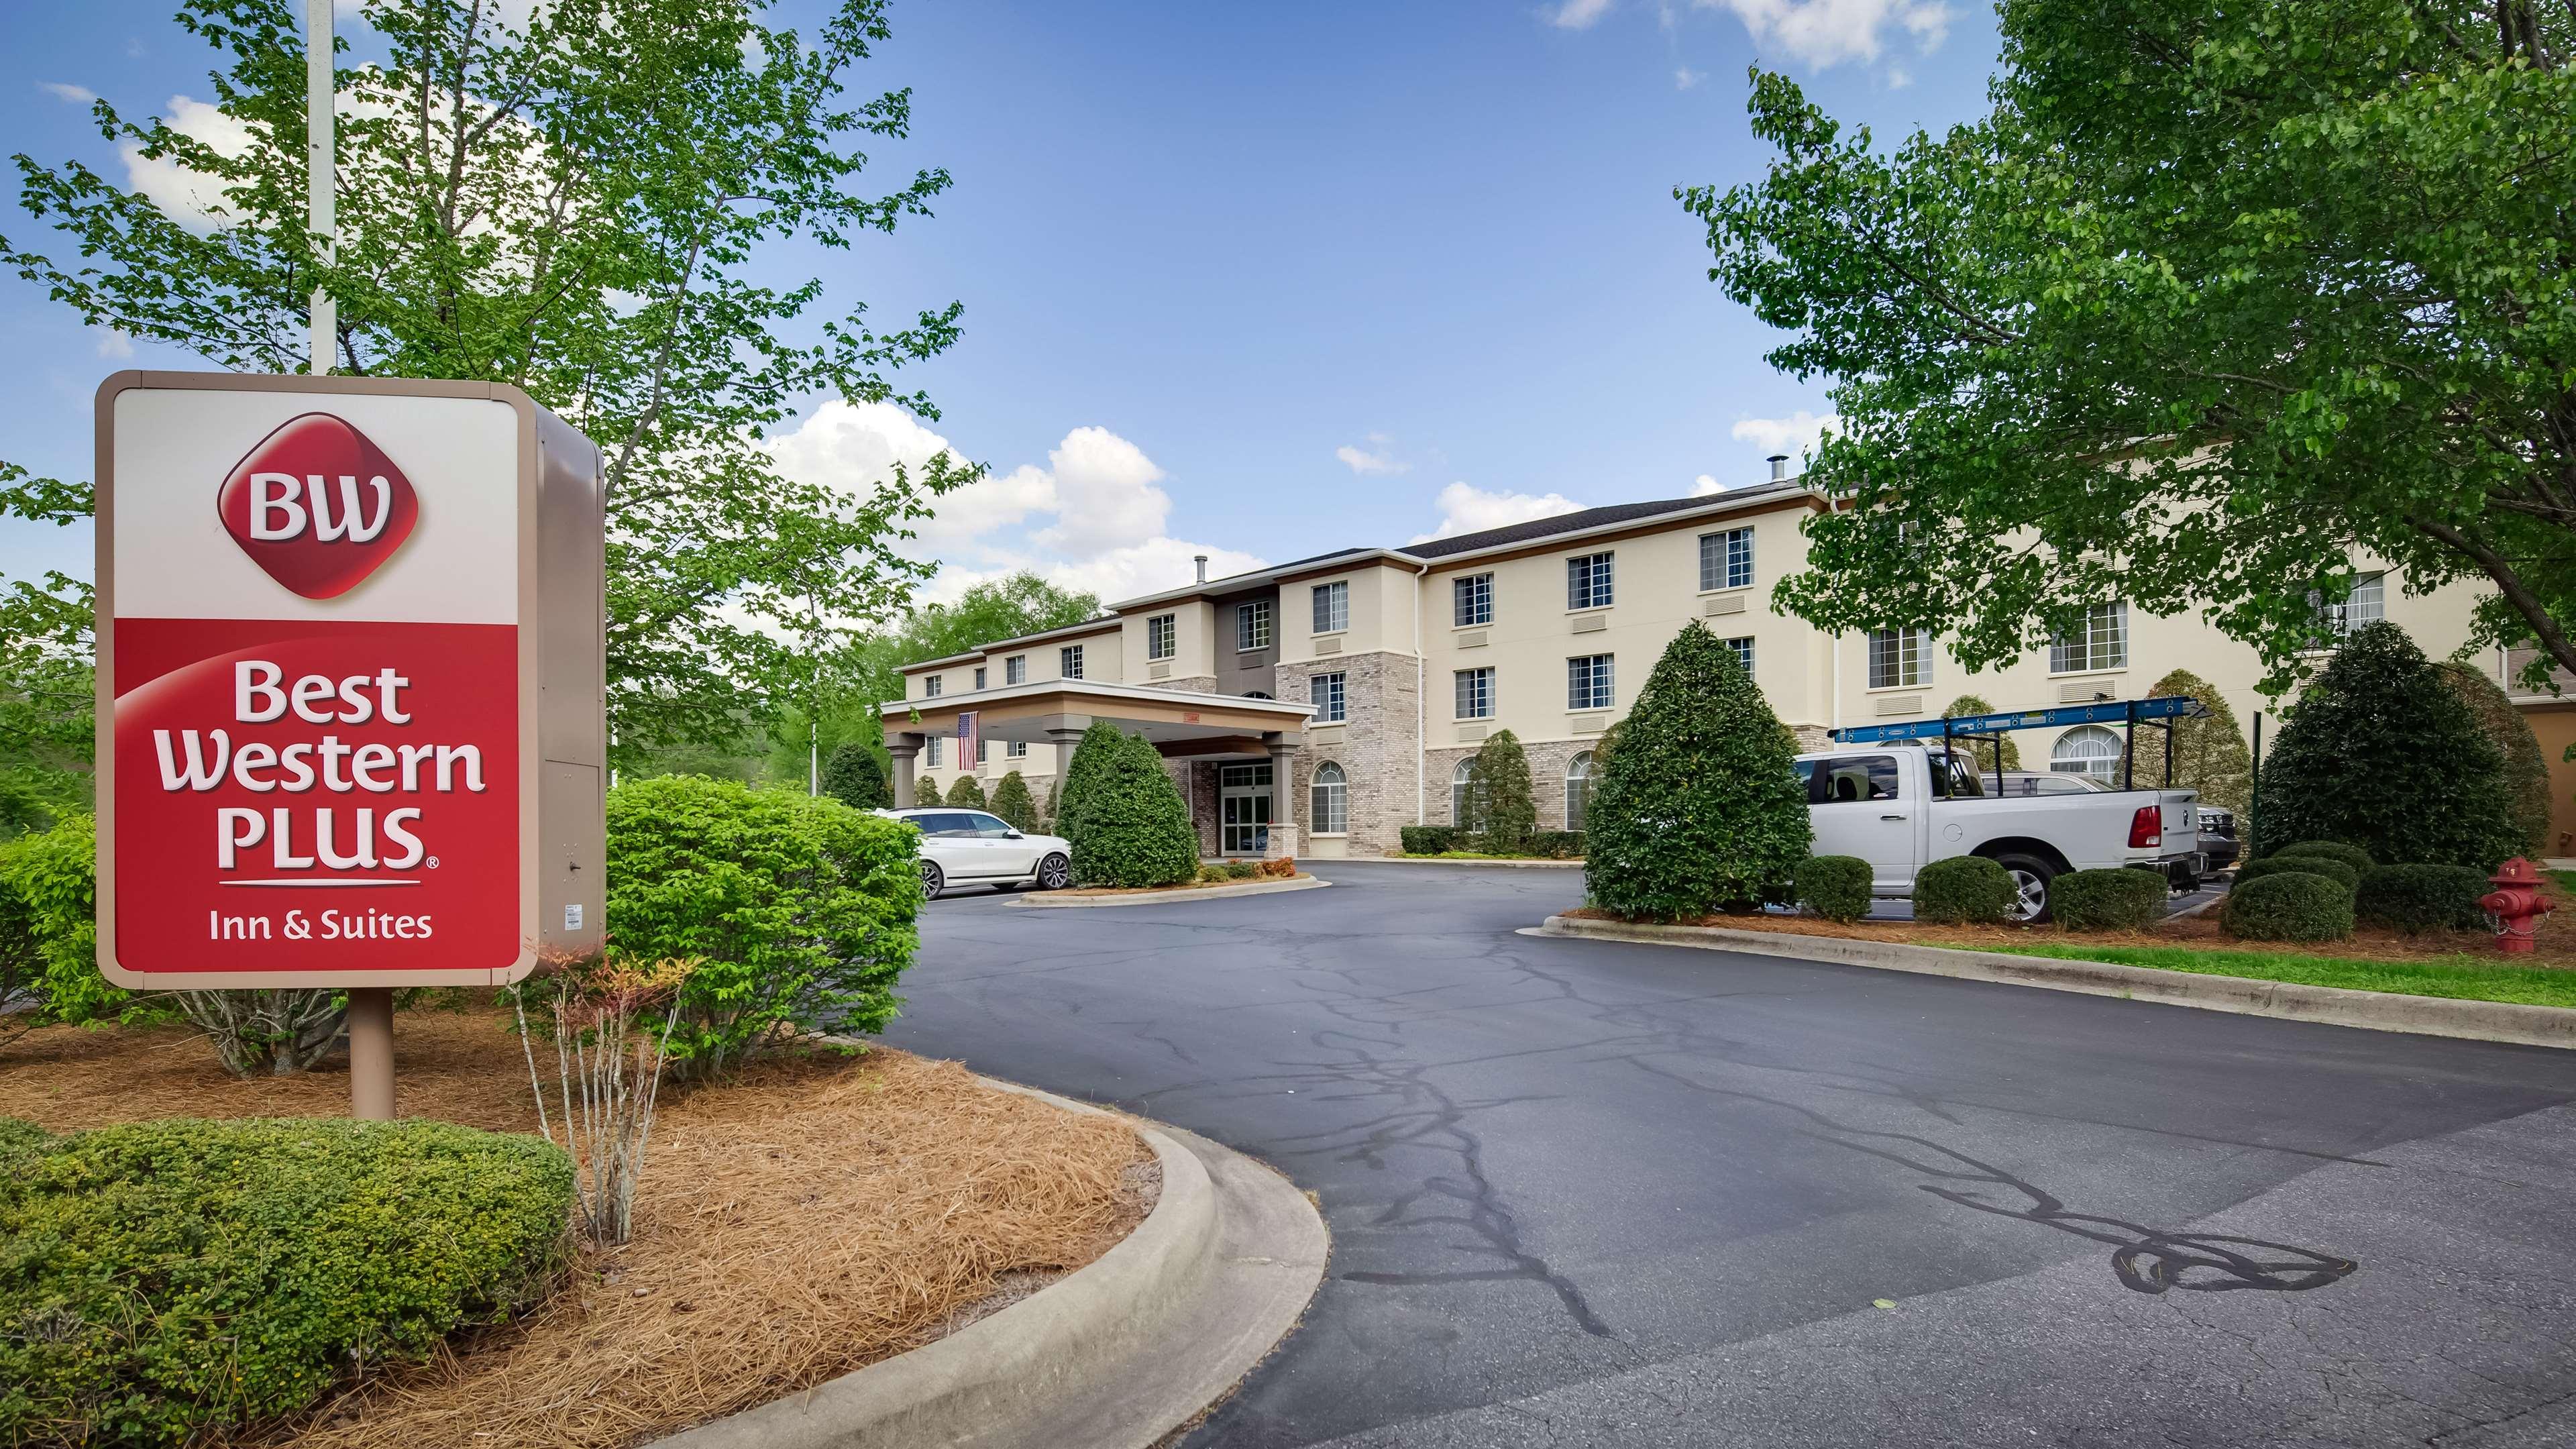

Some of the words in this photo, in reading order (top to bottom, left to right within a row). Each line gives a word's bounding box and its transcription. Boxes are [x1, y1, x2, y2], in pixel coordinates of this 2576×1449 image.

[250, 472, 391, 543] BW
[235, 660, 411, 724] Best
[153, 729, 486, 792] Western
[210, 910, 273, 941] Inn
[282, 909, 313, 941] &
[320, 908, 433, 940] Suites
